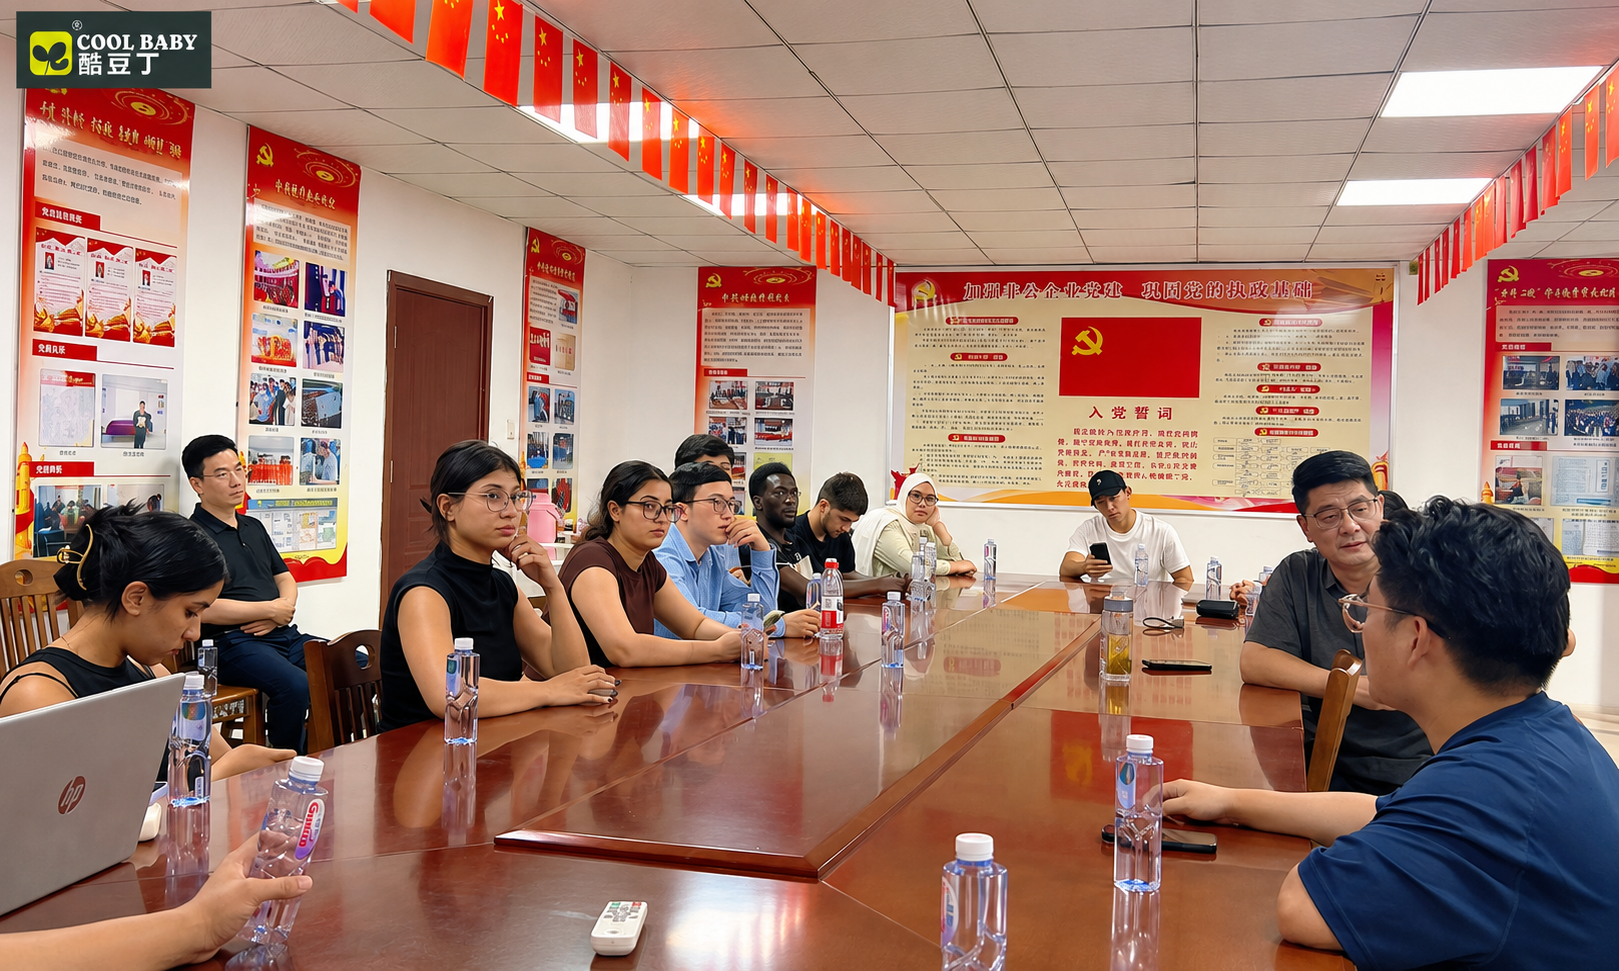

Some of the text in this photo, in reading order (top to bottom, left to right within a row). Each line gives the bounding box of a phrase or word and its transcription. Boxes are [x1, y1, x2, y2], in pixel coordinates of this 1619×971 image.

[1089, 405, 1172, 421] 入党誓词
[60, 779, 85, 814] hp
